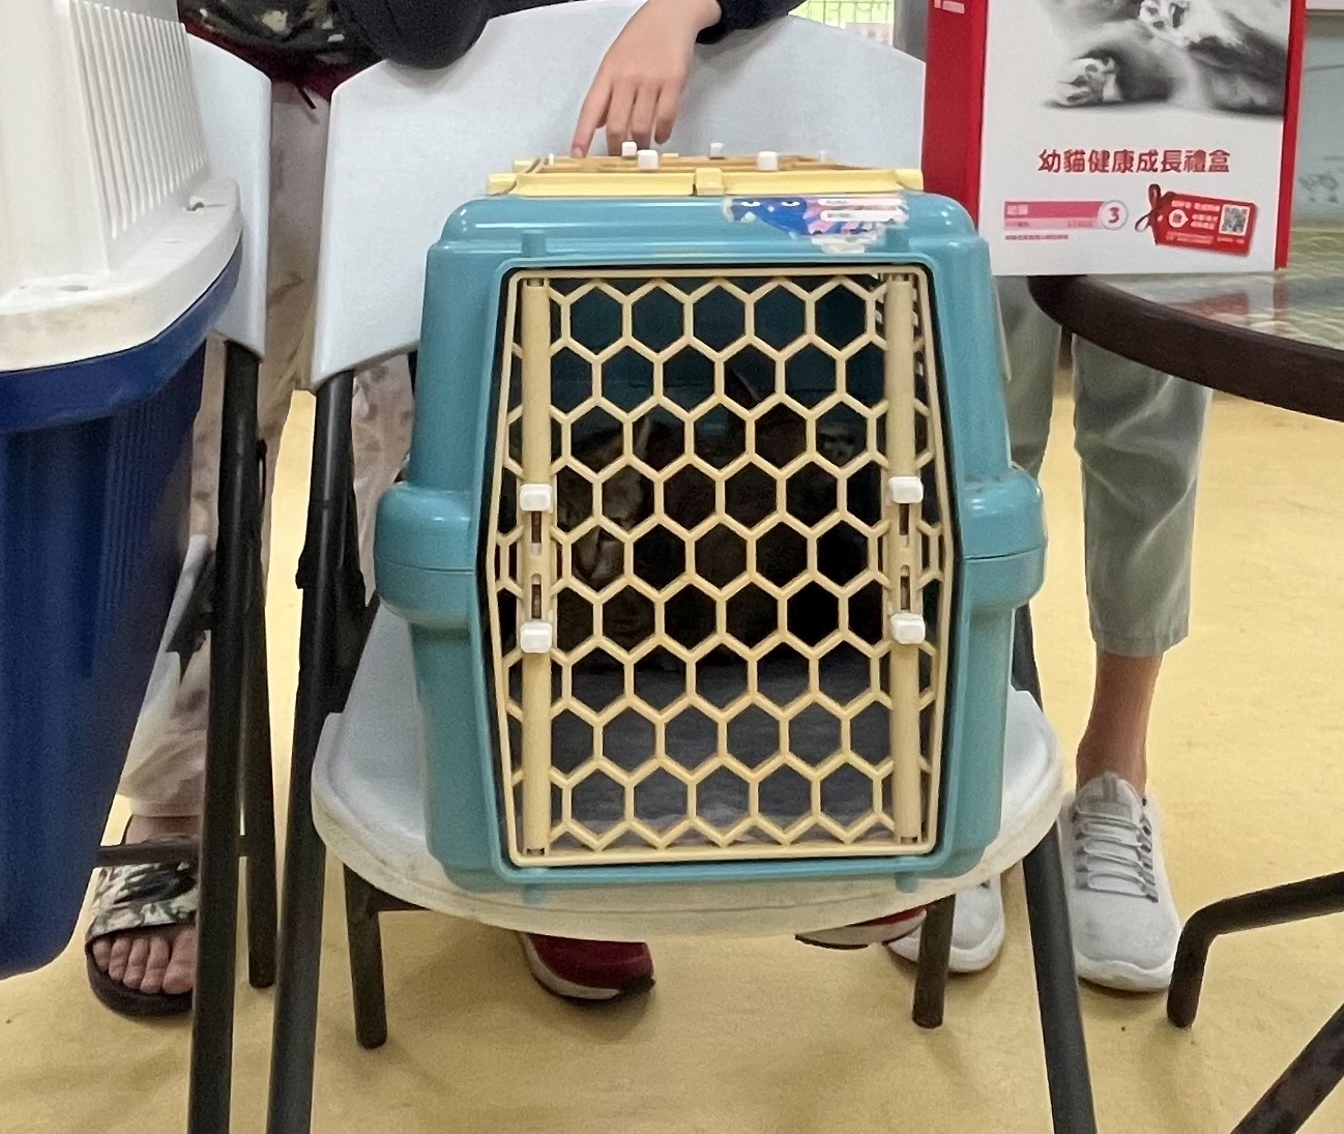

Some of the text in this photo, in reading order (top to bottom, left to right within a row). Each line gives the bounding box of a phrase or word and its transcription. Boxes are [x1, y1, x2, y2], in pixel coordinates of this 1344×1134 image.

[1038, 149, 1231, 173] 幼貓健康成長禮盒
[1108, 207, 1120, 224] 3
